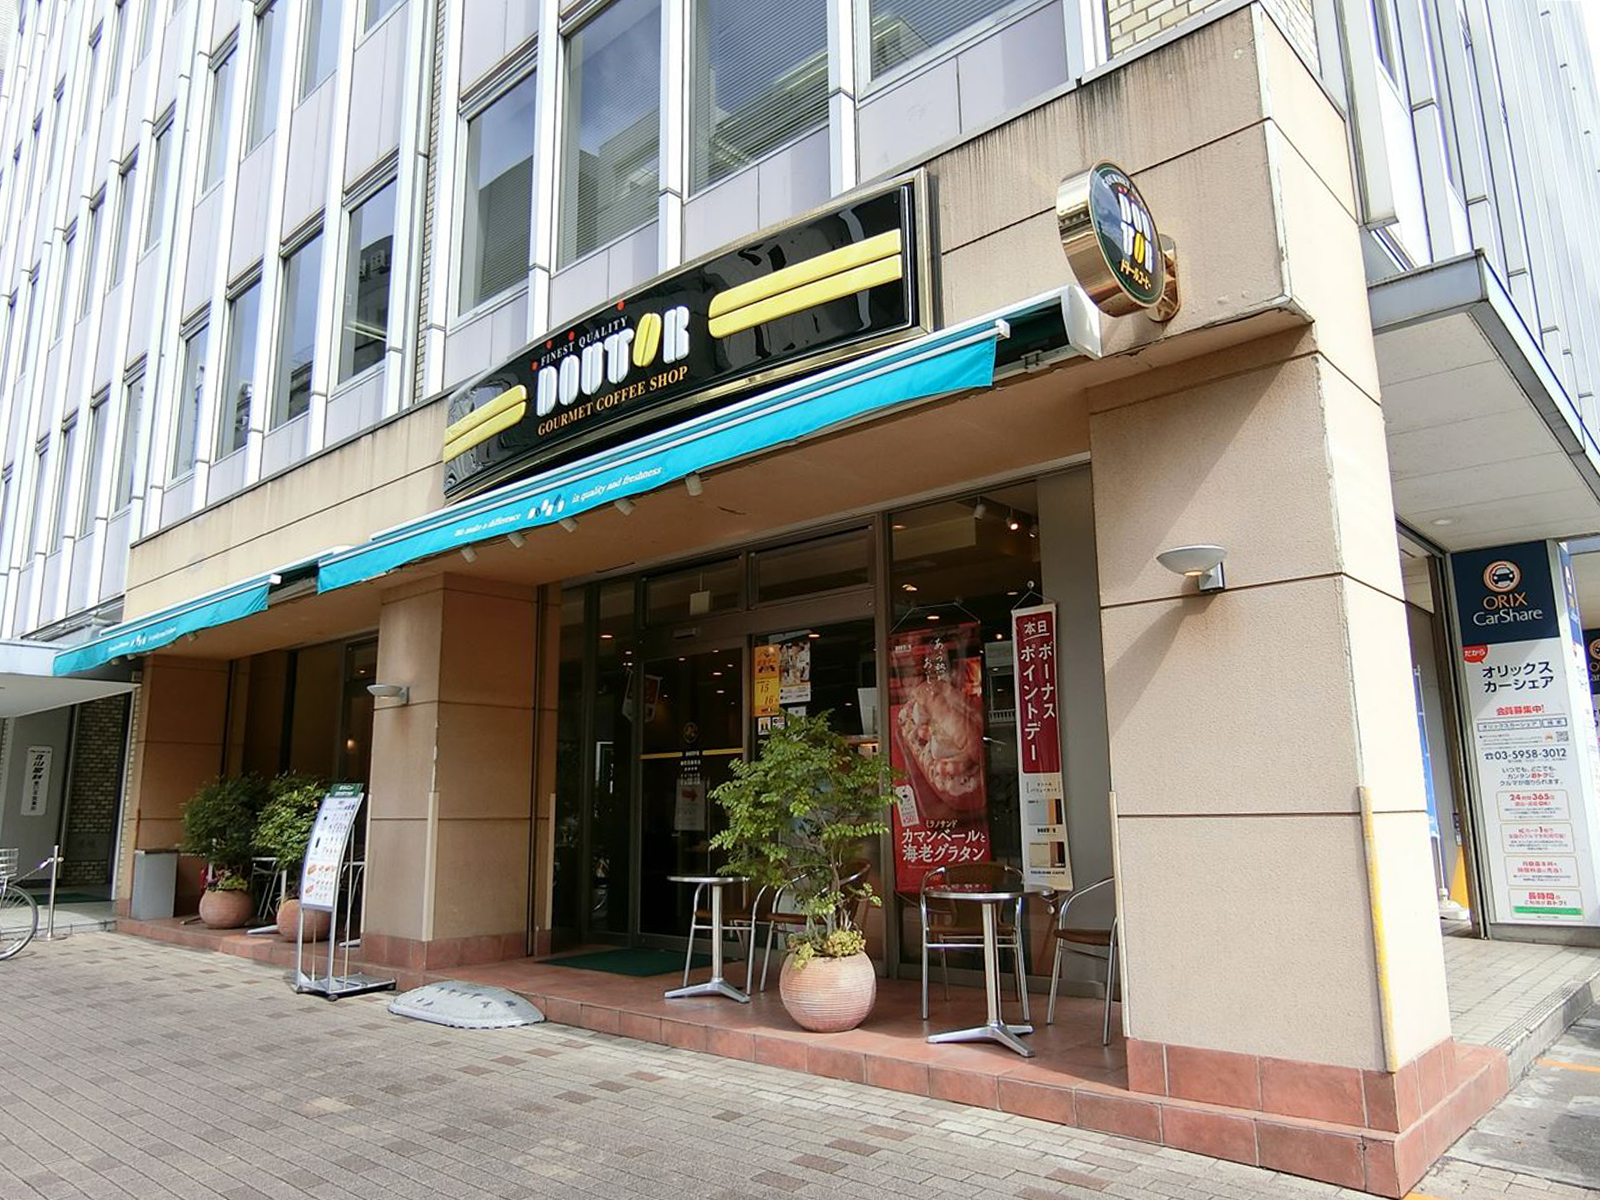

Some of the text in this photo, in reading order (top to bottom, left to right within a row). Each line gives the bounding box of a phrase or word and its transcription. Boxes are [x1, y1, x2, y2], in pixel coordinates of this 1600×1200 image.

[540, 315, 629, 367] FINEST QUALITY
[536, 305, 690, 417] DOUTOR
[537, 365, 688, 436] GOURMET COFFEE SHOP
[580, 483, 606, 503] quality
[606, 477, 622, 491] and
[622, 467, 662, 487] freshness
[1483, 591, 1528, 610] ORIX
[1473, 608, 1543, 626] CarShare
[1024, 620, 1047, 635] 本日
[1464, 648, 1486, 658] だから
[1482, 661, 1553, 679] オリックス
[1039, 641, 1056, 719] ボーナス
[1484, 676, 1554, 693] カーシェア
[1020, 643, 1041, 761] ポイントデー
[1494, 747, 1567, 760] 03-5958-3012
[901, 828, 986, 844] カマンベールと
[902, 843, 985, 863] 海老グラタン
